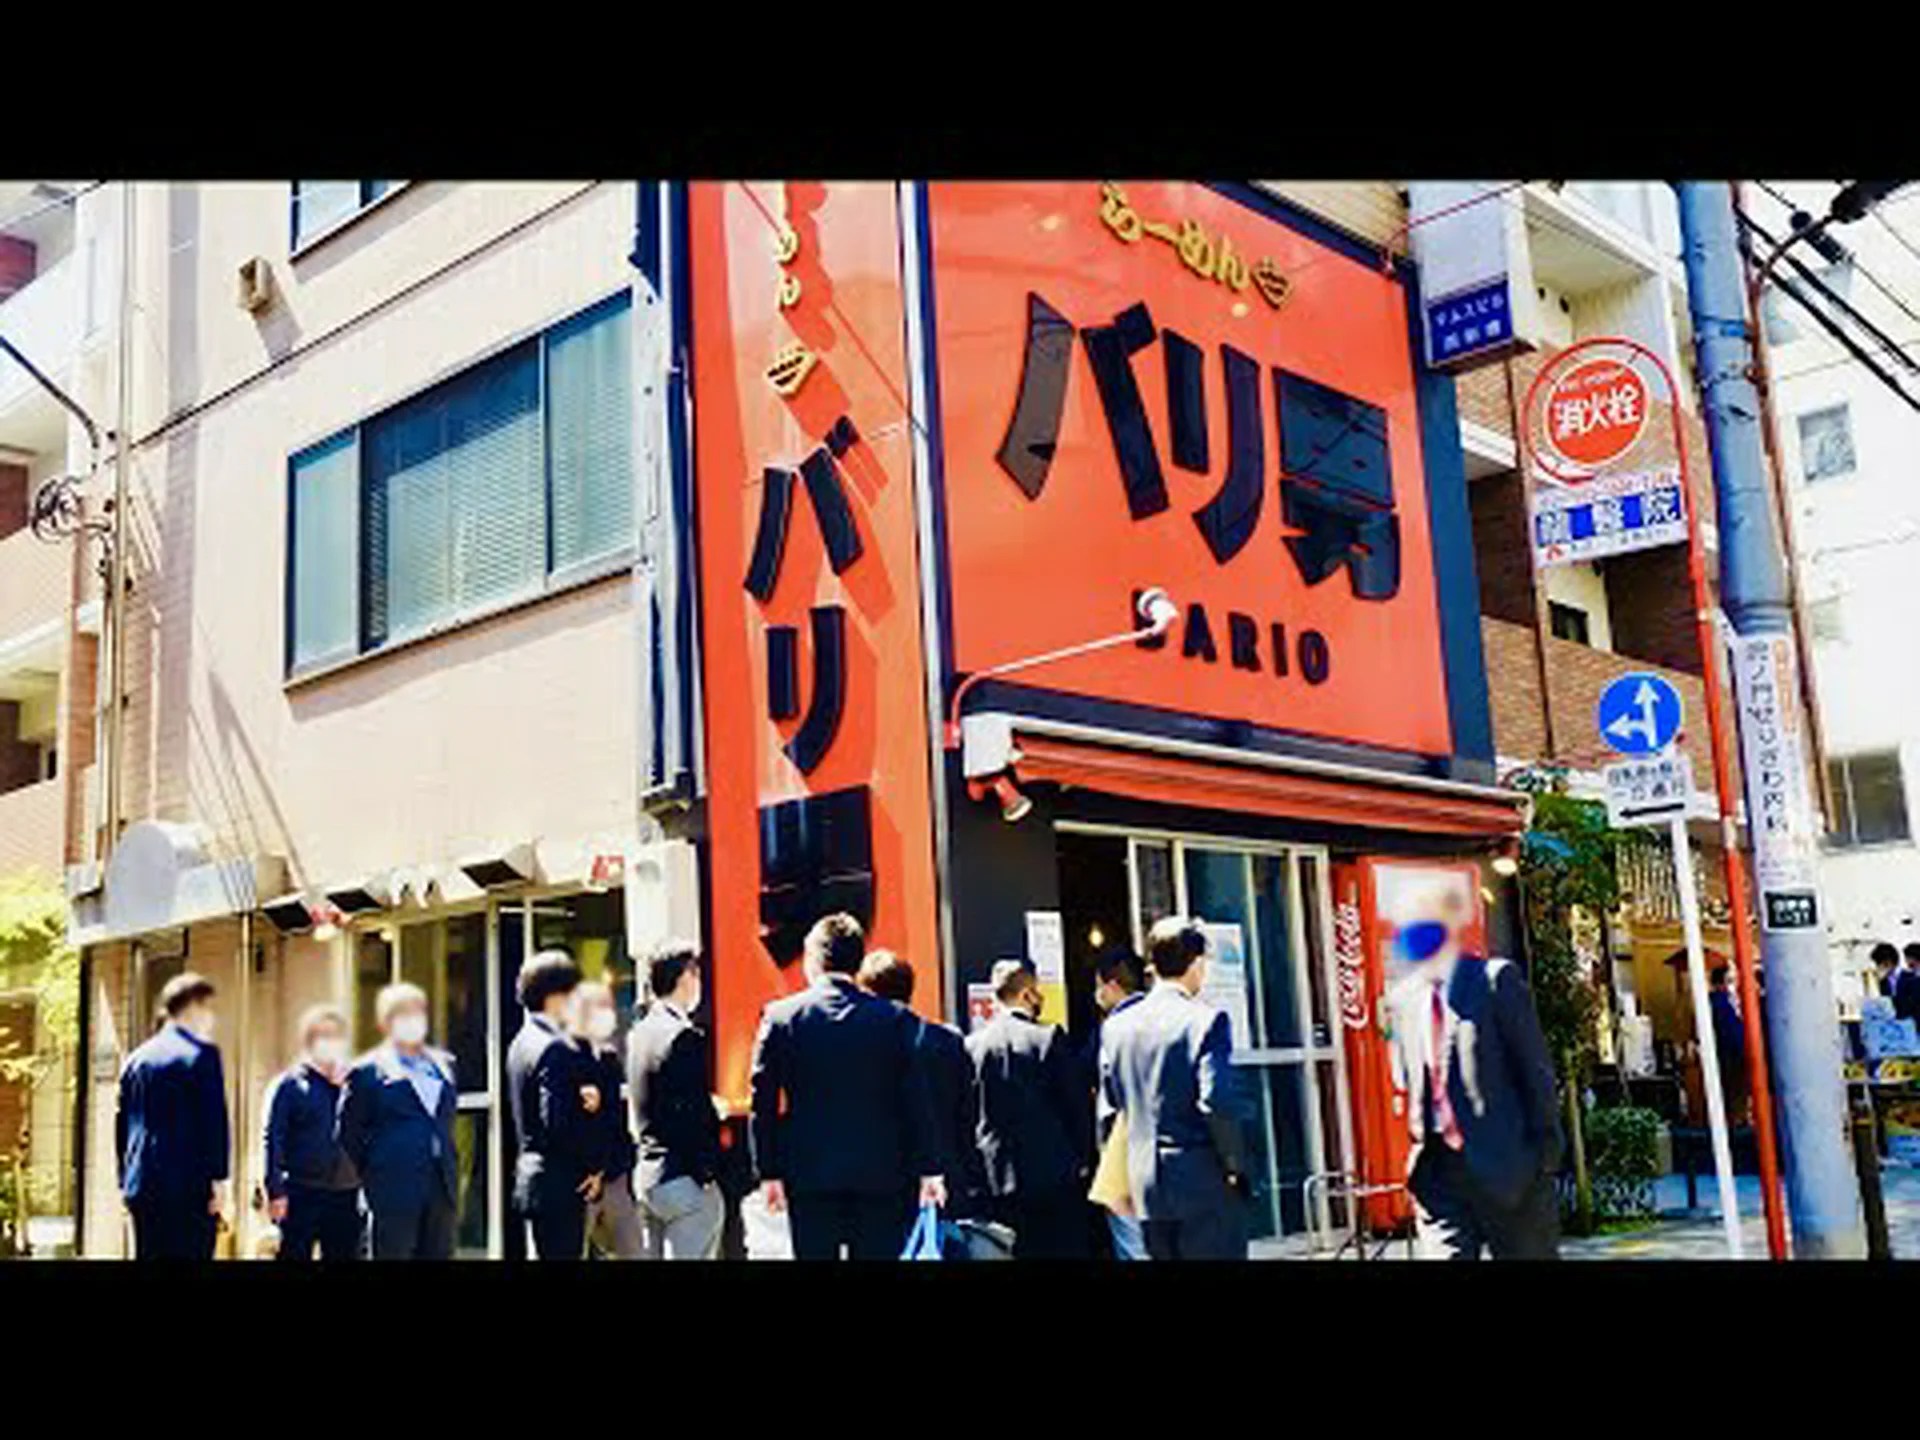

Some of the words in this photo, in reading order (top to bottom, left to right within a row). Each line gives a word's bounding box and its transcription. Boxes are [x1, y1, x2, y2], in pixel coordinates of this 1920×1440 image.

[995, 290, 1401, 602] バリ男
[1555, 384, 1640, 441] 消火栓
